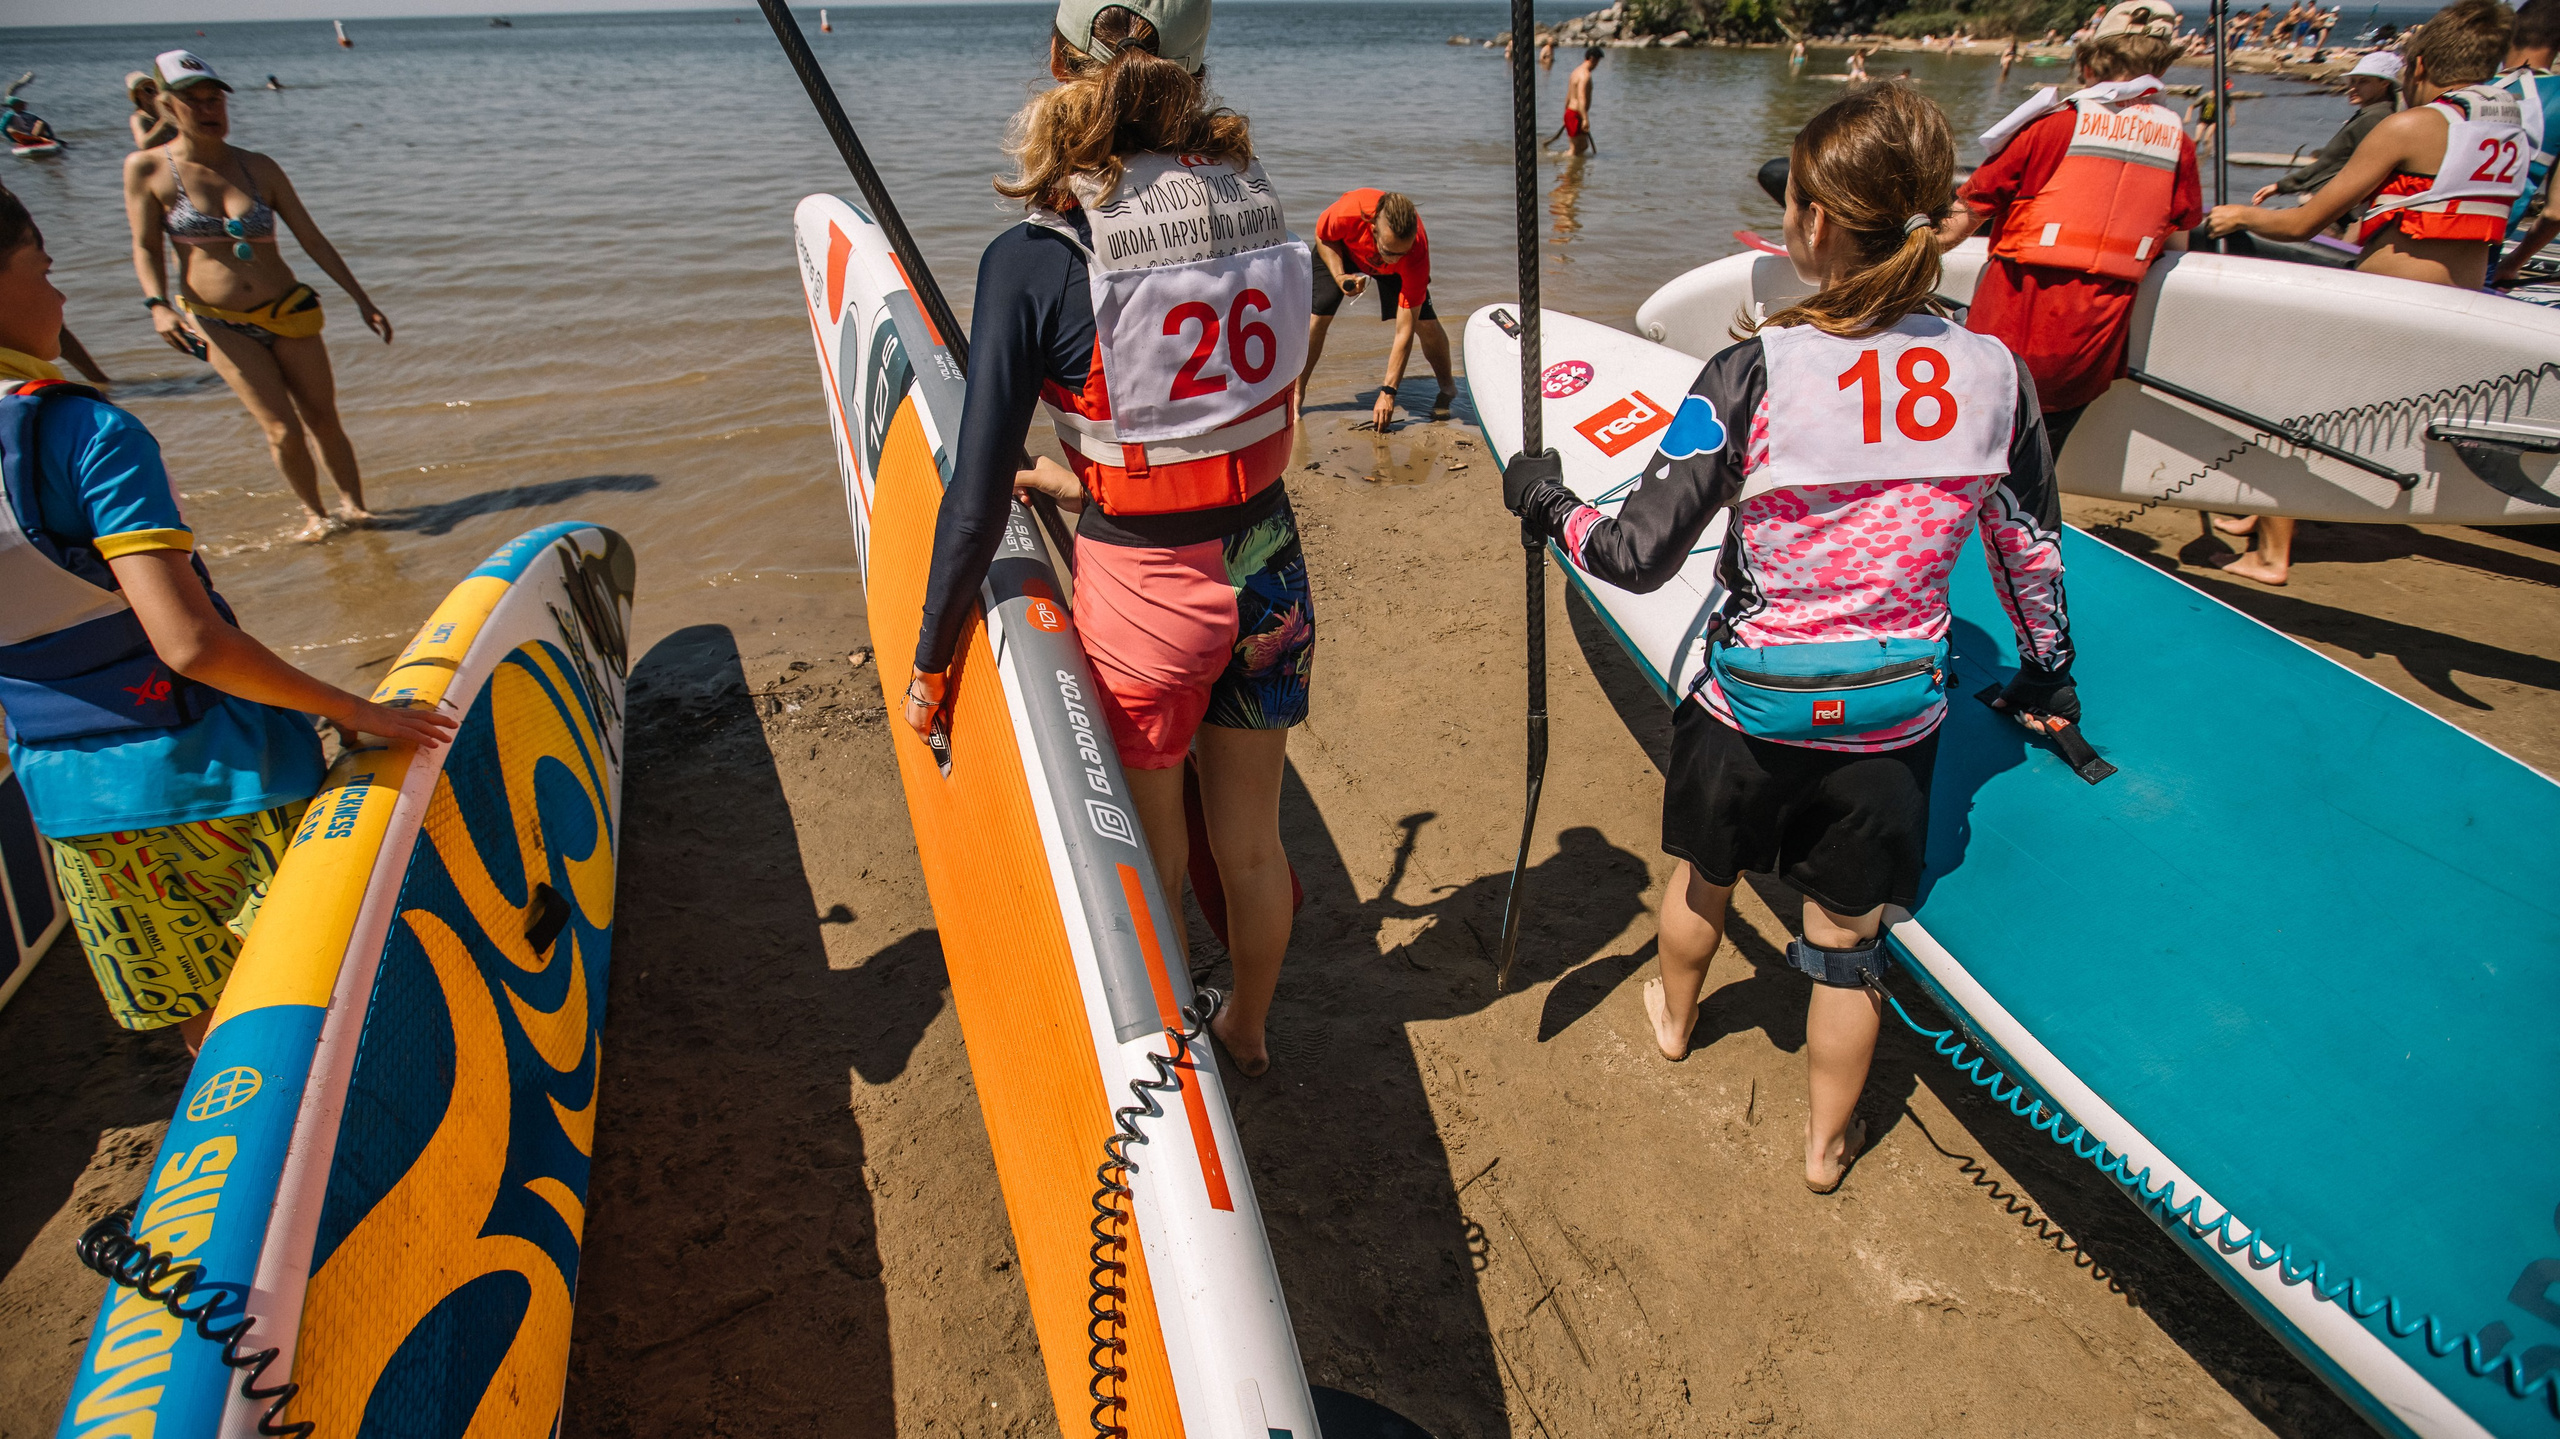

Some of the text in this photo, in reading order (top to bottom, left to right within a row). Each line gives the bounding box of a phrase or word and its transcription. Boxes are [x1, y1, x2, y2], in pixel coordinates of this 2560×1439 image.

[2469, 138, 2518, 184] 22
[1107, 205, 1279, 260] ШКОЛА ПАРУСНОГО СПОРТА
[933, 353, 951, 381] VOLUME
[1162, 288, 1277, 402] 26
[1837, 346, 1959, 445] 18
[1593, 397, 1658, 445] red
[1815, 701, 1842, 720] red
[324, 772, 375, 839] THICKNESS
[74, 856, 97, 901] TERMIT
[139, 912, 166, 952] TERMIT
[176, 954, 203, 991] TERMIT
